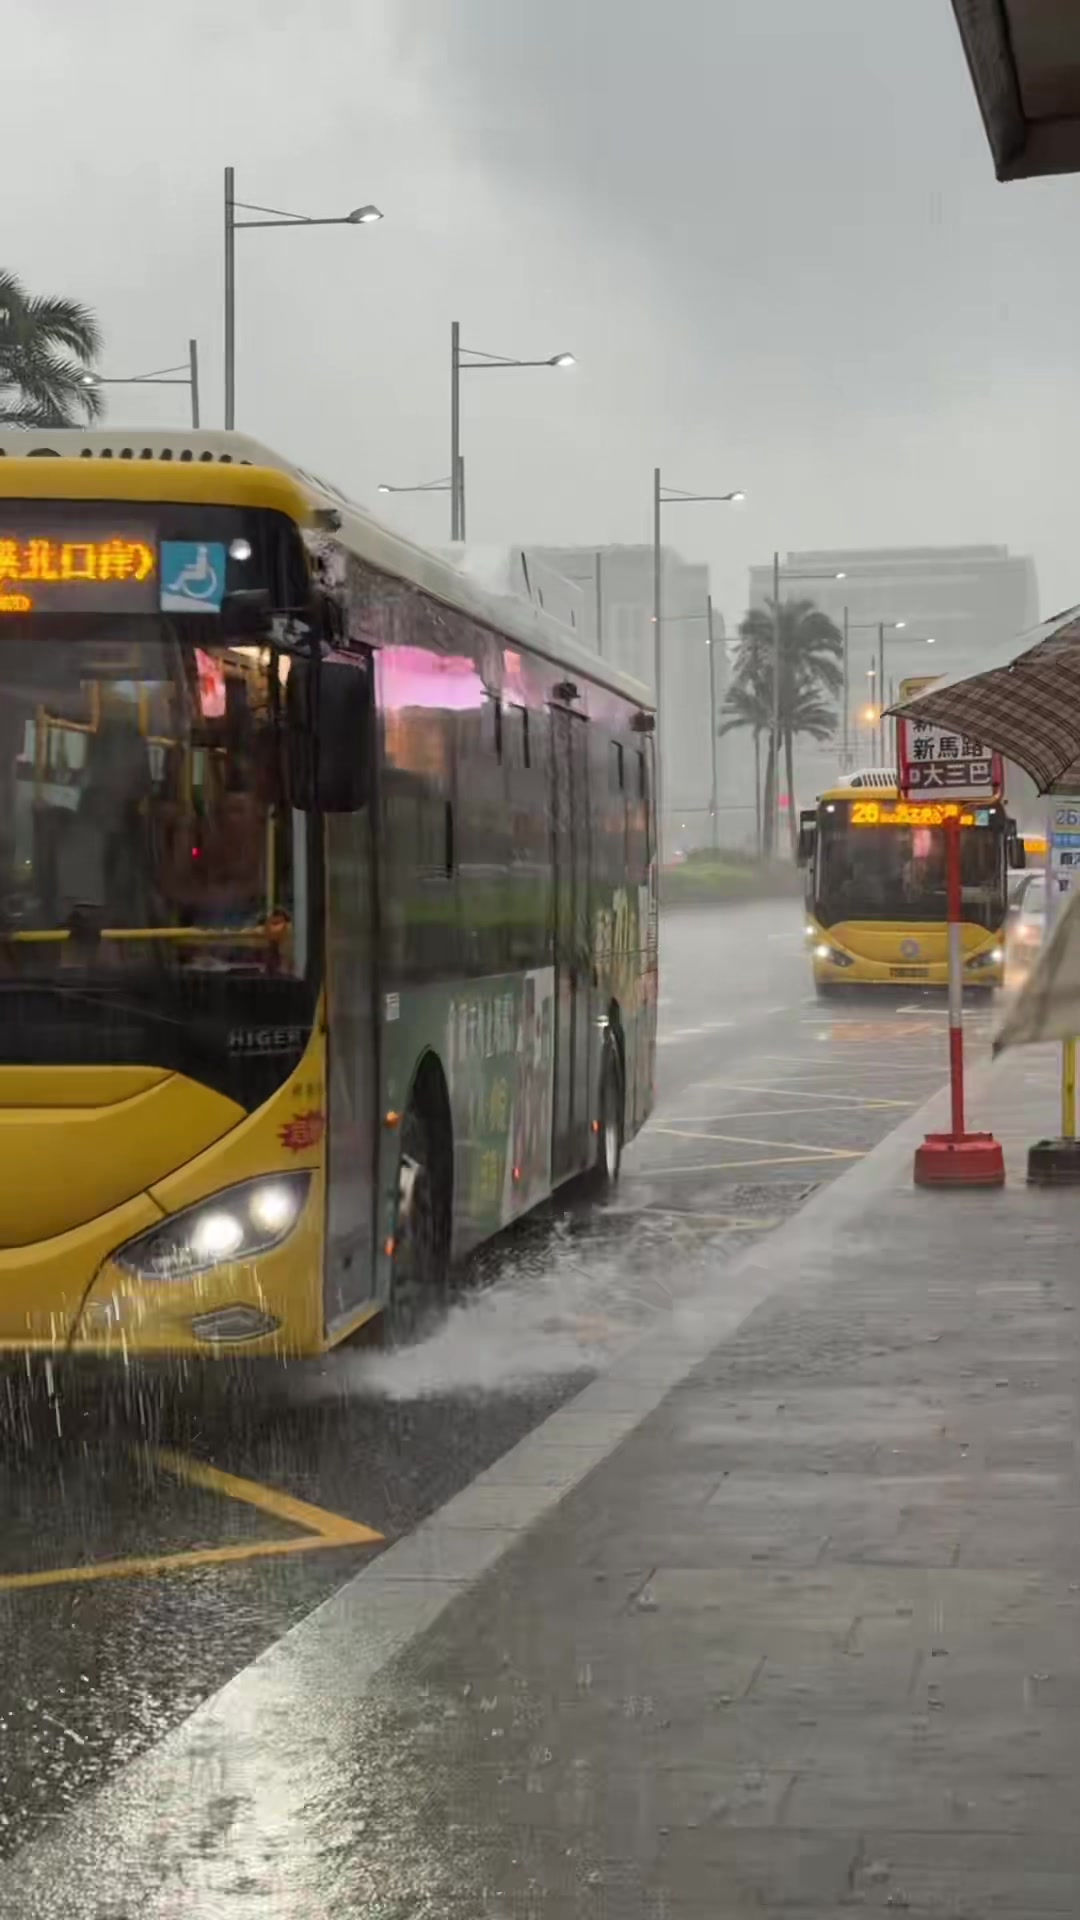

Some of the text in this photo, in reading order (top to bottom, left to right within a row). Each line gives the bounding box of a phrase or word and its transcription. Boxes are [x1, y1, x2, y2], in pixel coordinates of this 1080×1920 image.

[913, 736, 984, 760] 新馬路
[229, 1029, 302, 1047] HIGER
